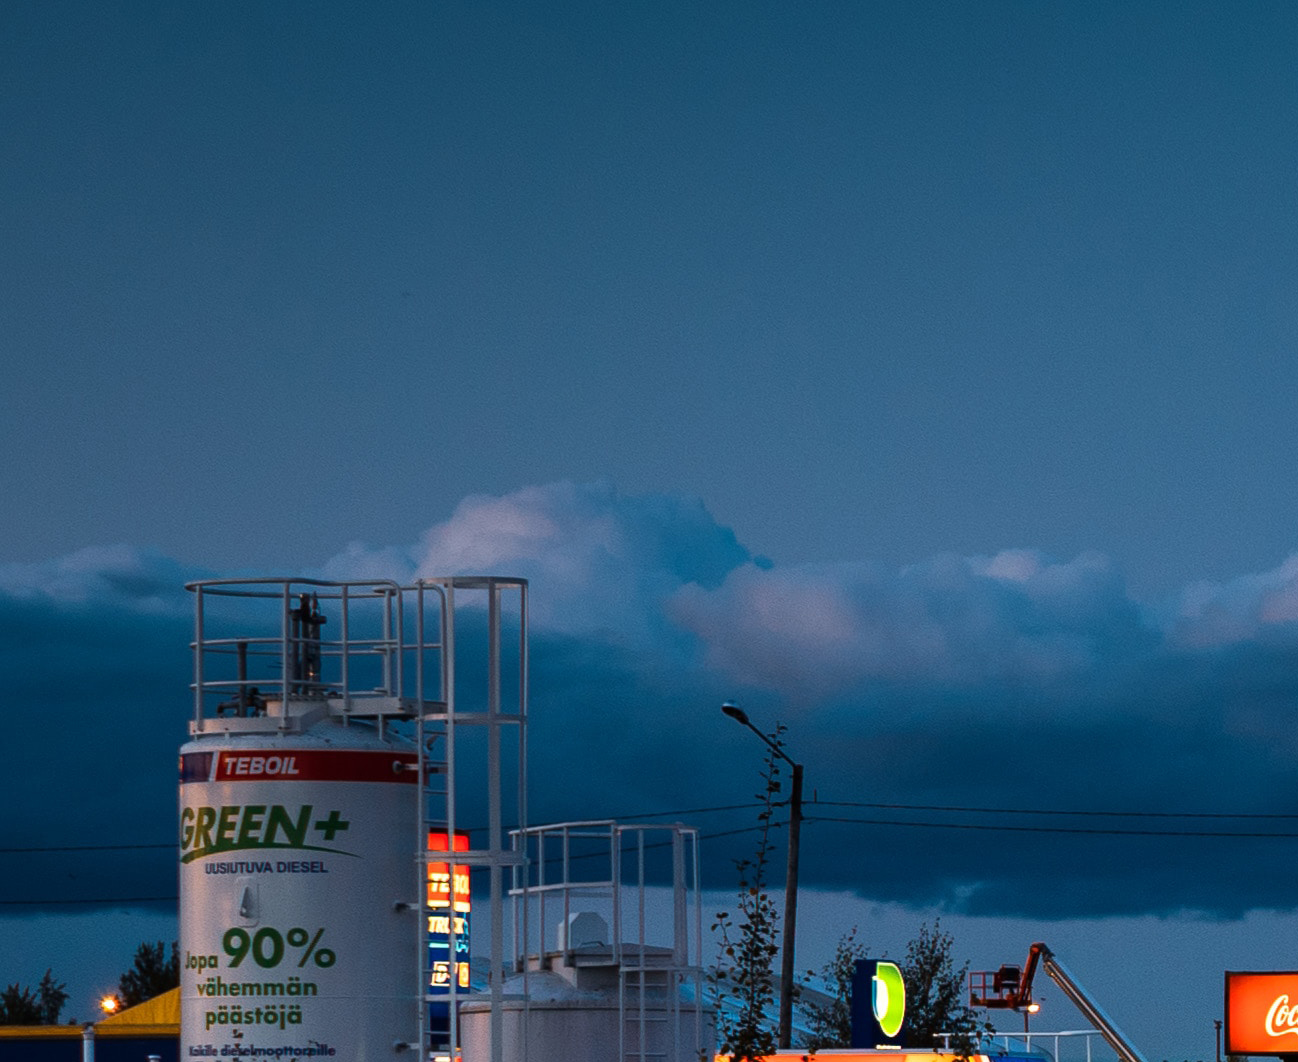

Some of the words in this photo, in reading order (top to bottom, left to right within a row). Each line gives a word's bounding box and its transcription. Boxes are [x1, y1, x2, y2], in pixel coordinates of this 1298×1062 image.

[224, 756, 299, 775] TEBOIL
[181, 804, 350, 850] GREEN+
[205, 862, 273, 874] UUSIUTUVA
[276, 861, 329, 874] DIESEL
[185, 951, 218, 974] Jopa
[222, 927, 336, 968] 90%
[197, 976, 318, 996] vähemmän
[205, 1004, 302, 1031] päästöjä
